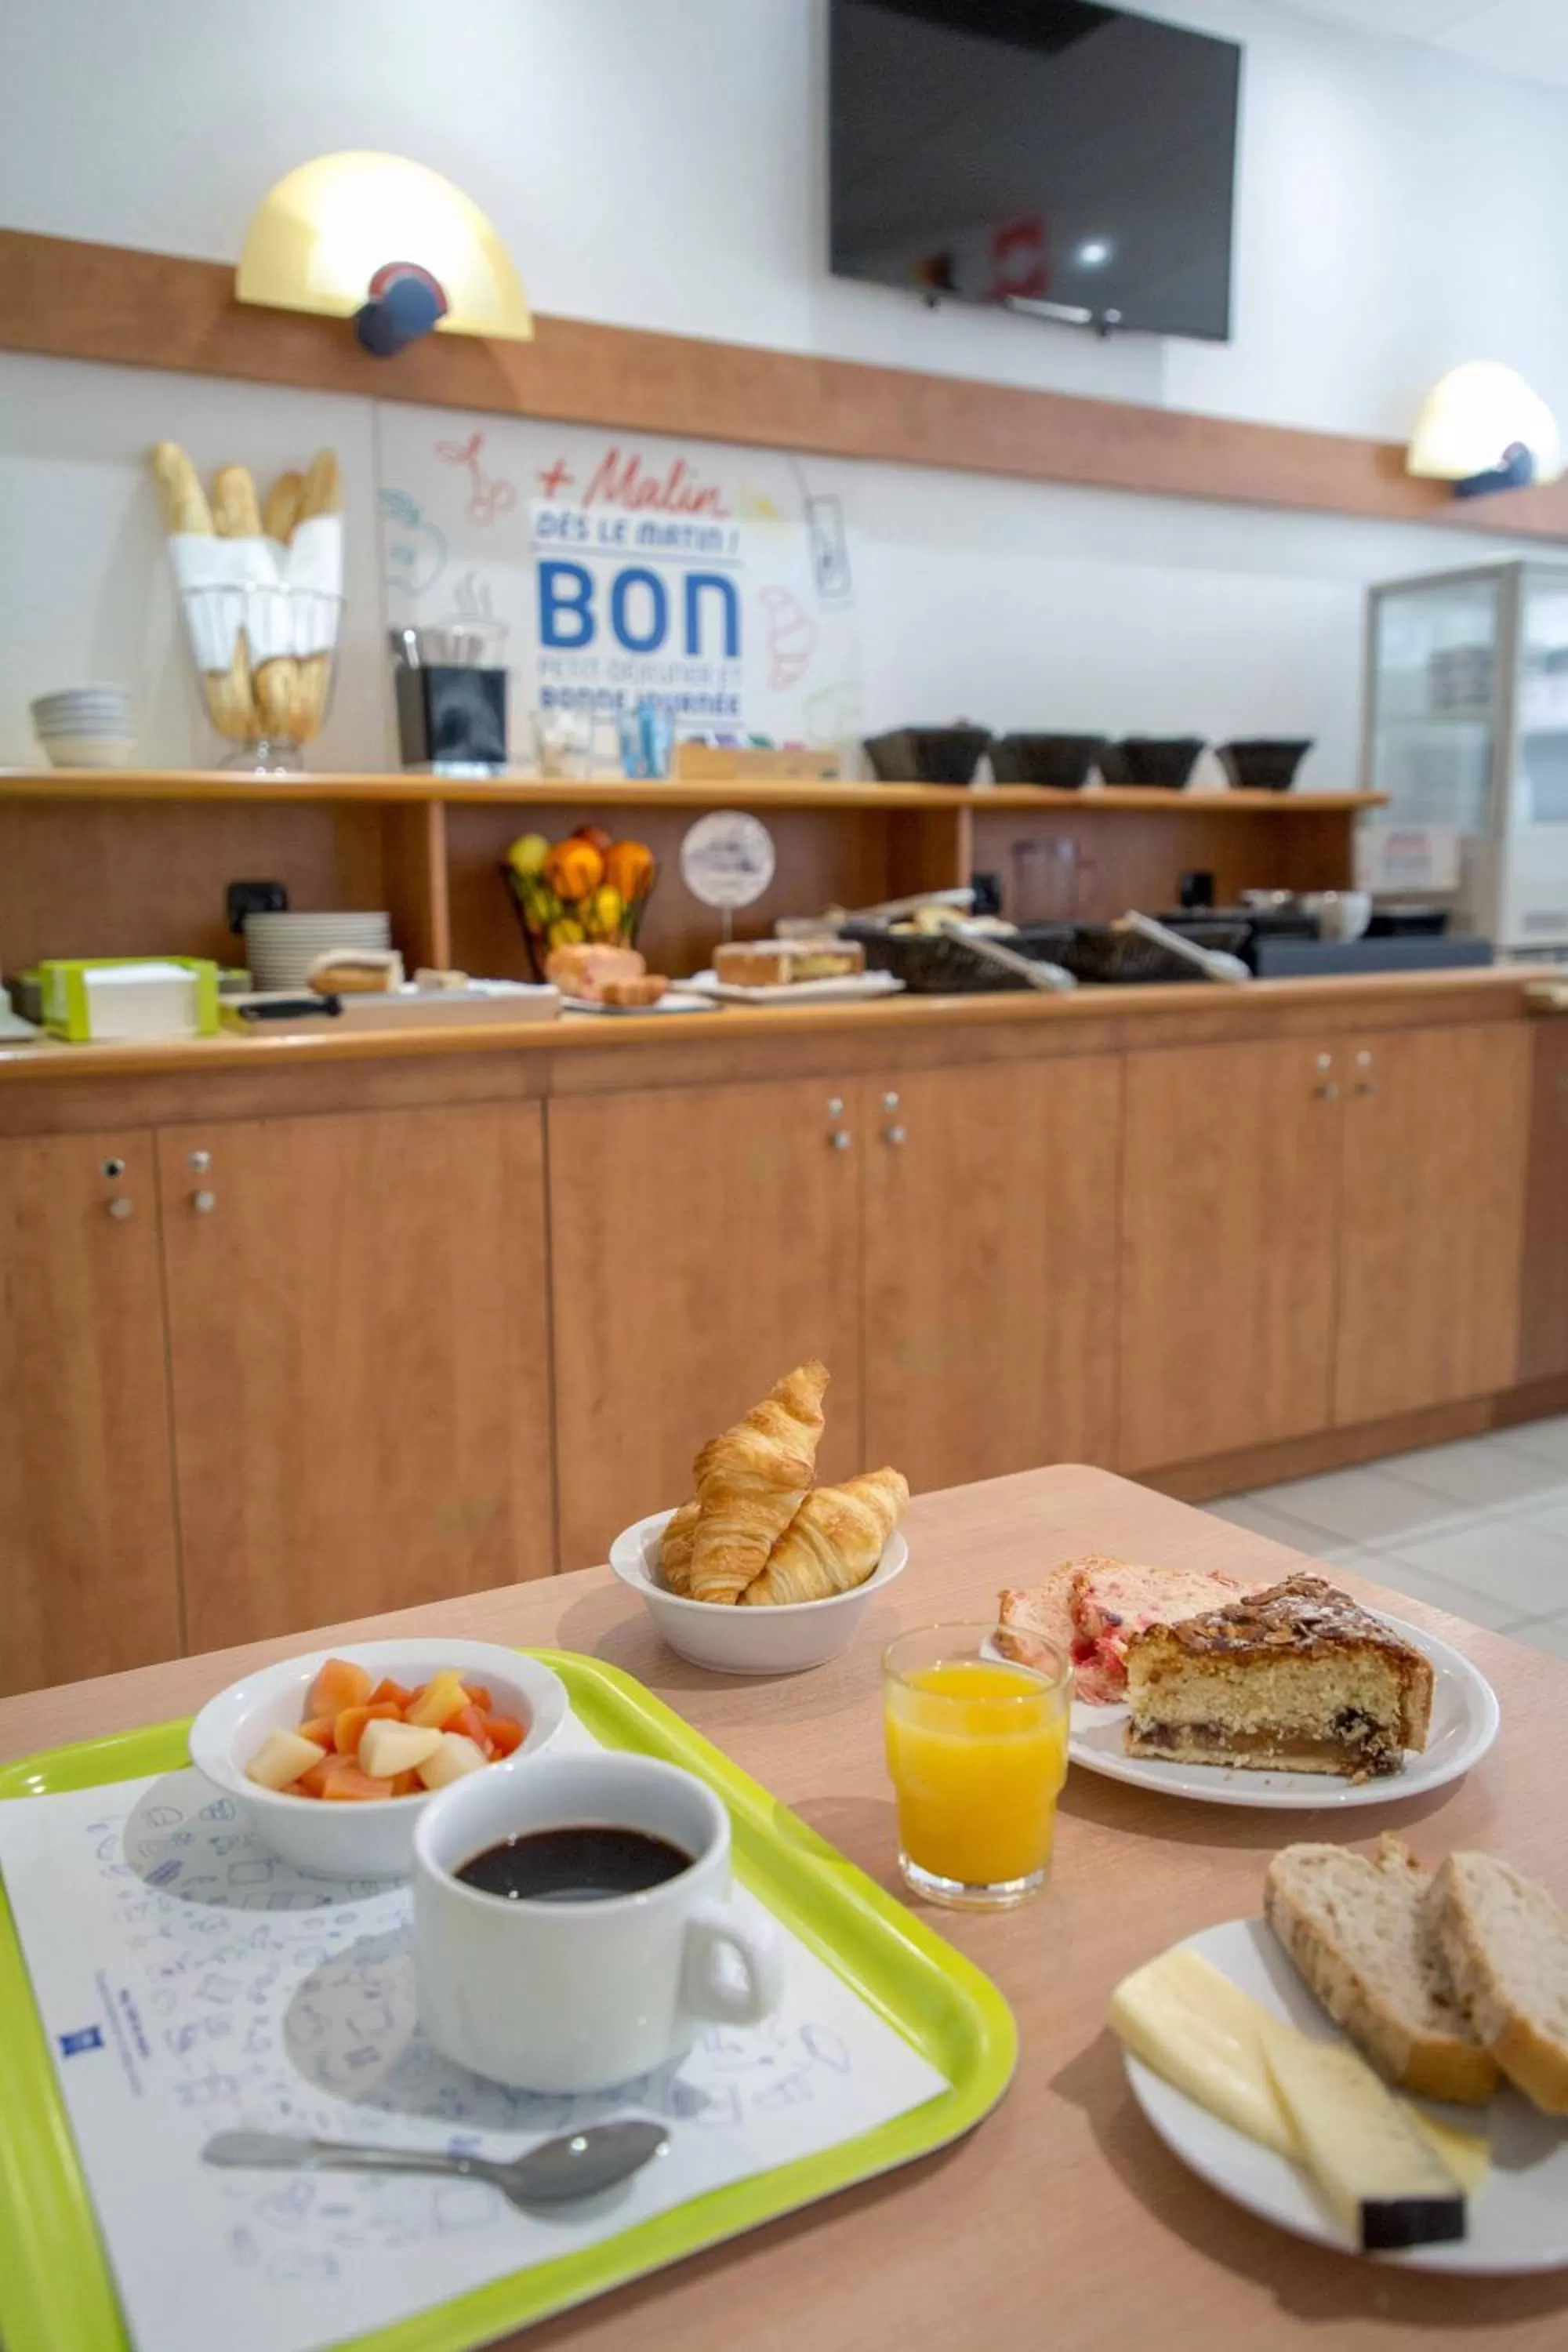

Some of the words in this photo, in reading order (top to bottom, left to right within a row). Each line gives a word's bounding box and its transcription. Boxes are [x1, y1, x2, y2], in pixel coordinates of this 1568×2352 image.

[580, 446, 732, 517] Malin
[598, 518, 626, 543] LE
[634, 521, 723, 551] MATIN
[539, 560, 739, 657] BON
